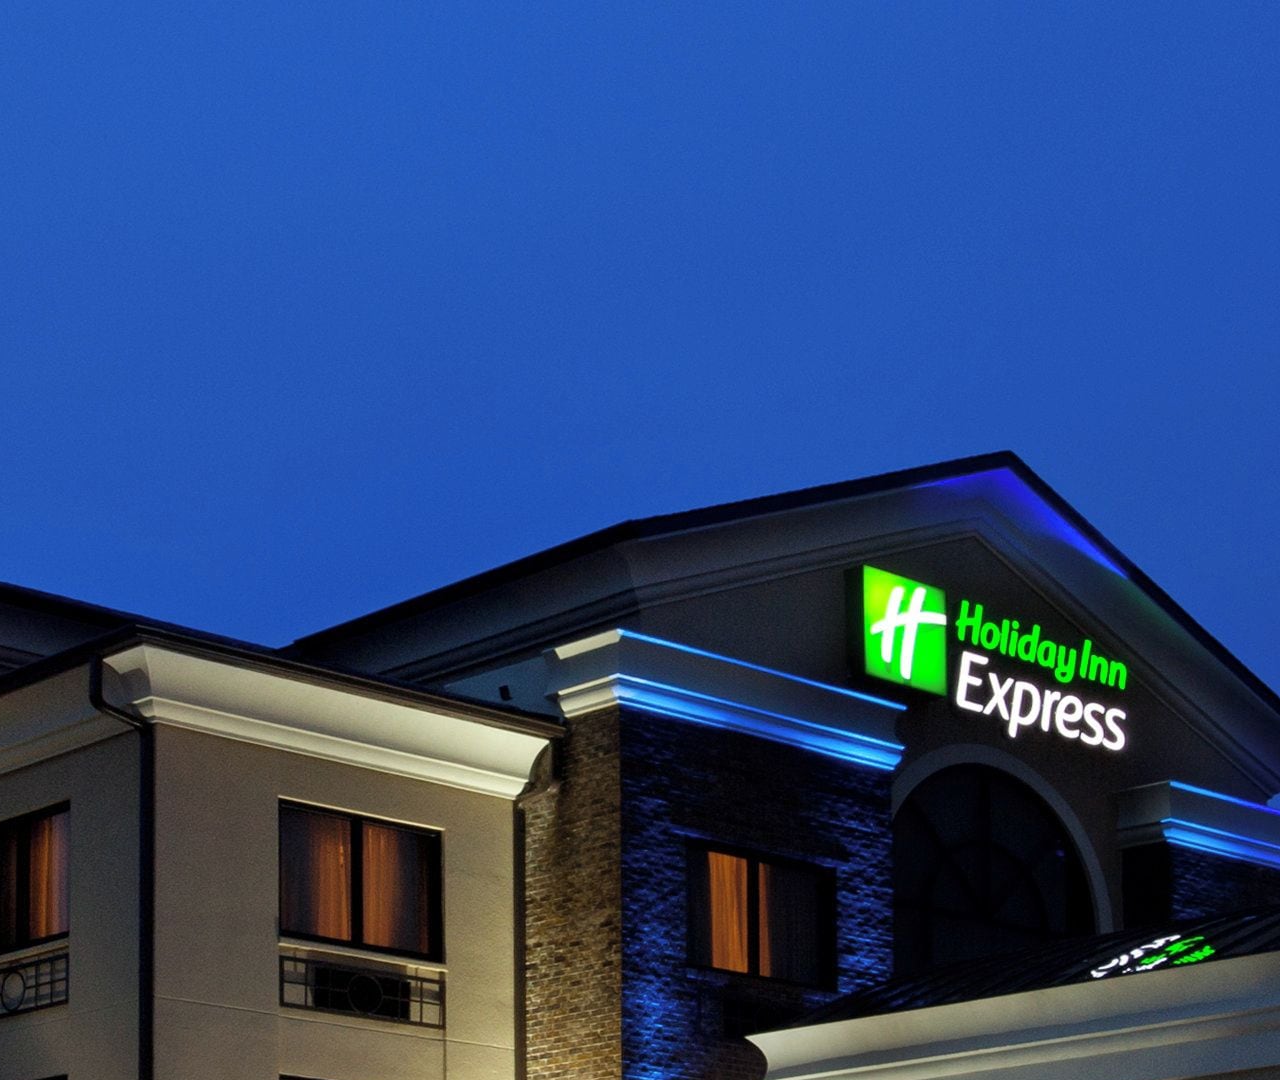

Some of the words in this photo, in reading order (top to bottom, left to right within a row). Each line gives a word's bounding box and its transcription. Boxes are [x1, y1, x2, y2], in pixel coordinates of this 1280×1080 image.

[955, 599, 1077, 683] Holiday
[1079, 639, 1127, 690] Inn
[956, 650, 1126, 751] Express
